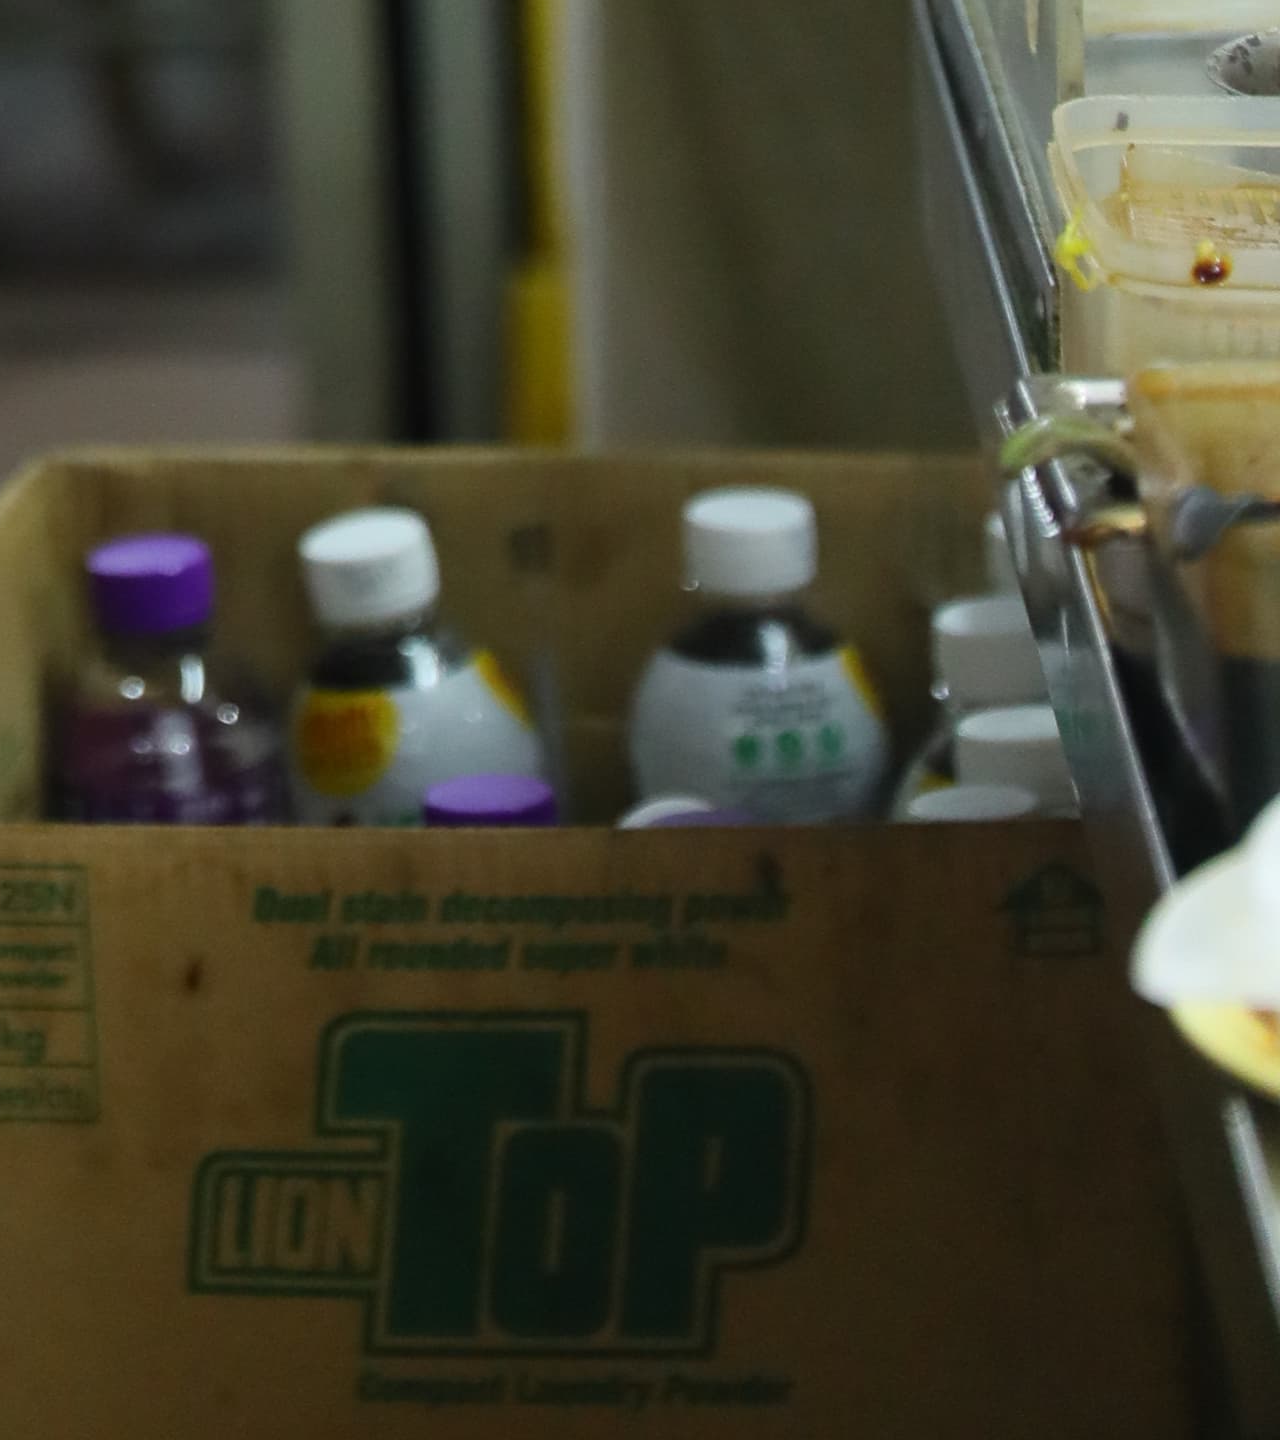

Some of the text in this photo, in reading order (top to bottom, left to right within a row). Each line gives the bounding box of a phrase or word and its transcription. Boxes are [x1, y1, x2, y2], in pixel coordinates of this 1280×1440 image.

[253, 885, 330, 924] Dual
[342, 889, 427, 923] stain
[439, 890, 672, 929] decomposing
[309, 935, 728, 974] All rounded super white
[216, 1171, 382, 1278] LION
[357, 1371, 794, 1411] Compact Laundry Powder
